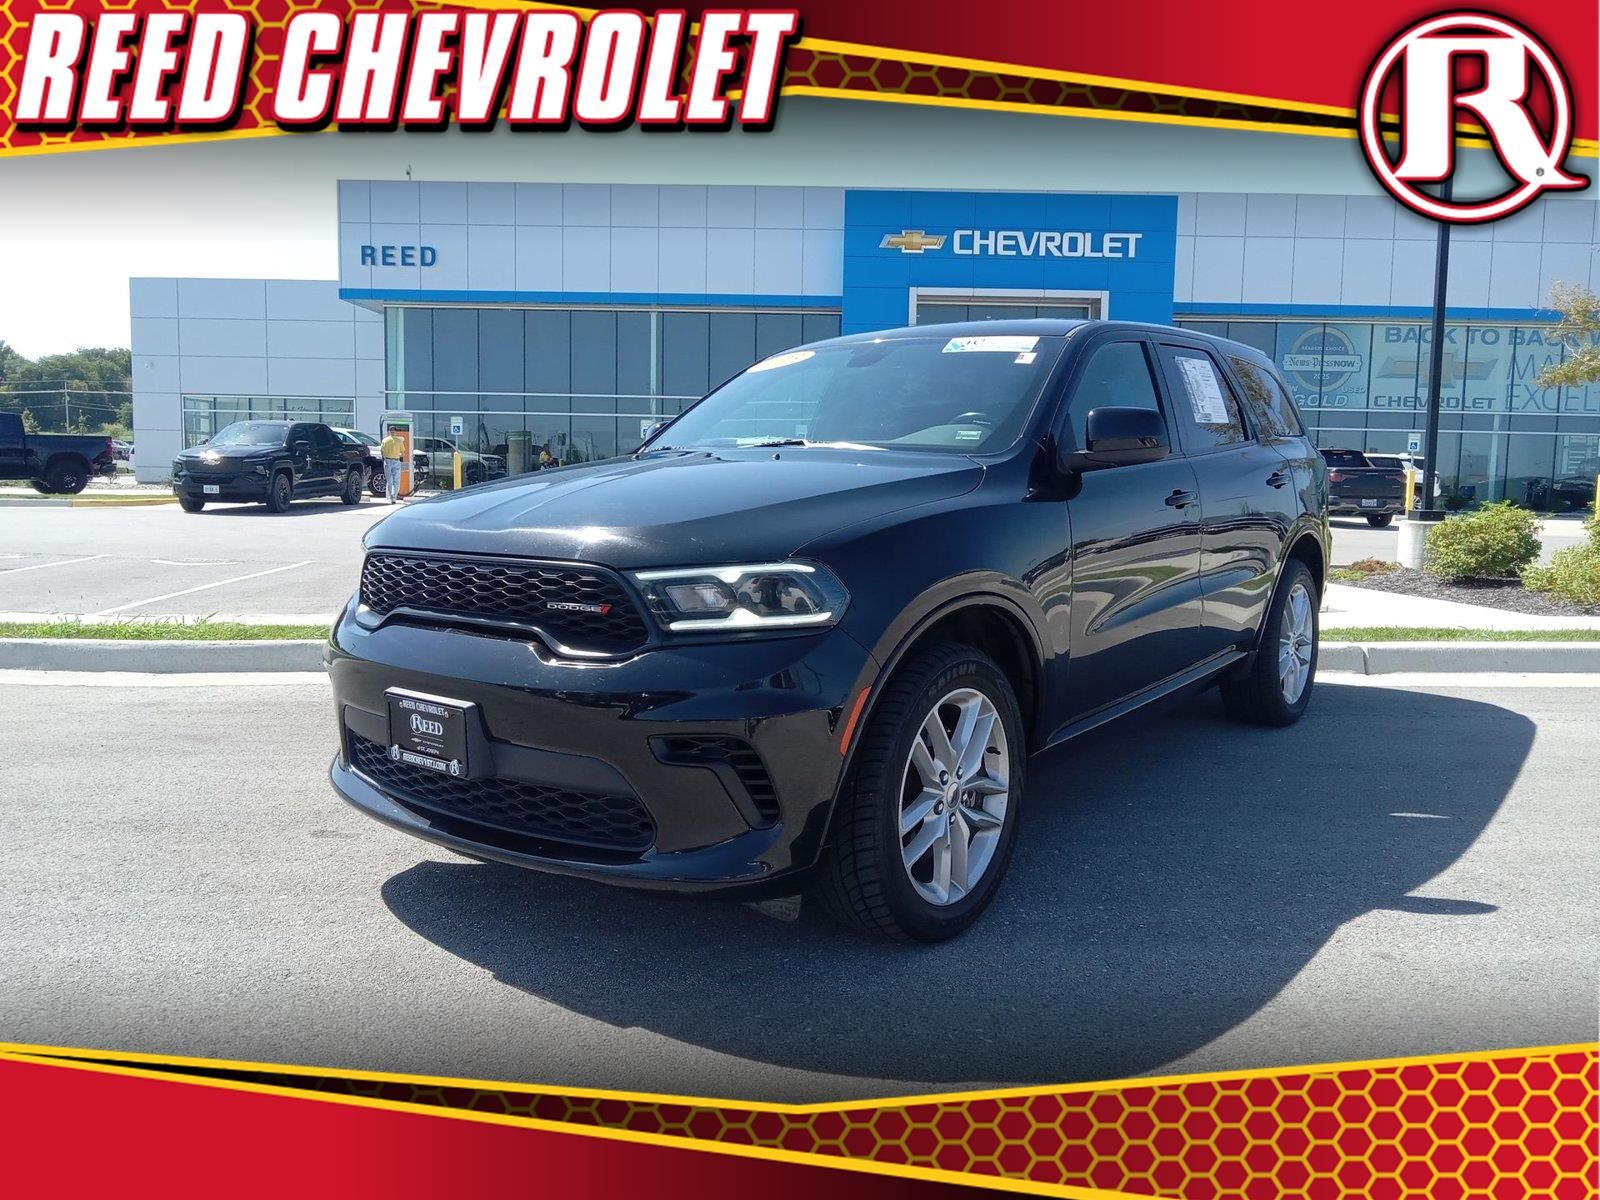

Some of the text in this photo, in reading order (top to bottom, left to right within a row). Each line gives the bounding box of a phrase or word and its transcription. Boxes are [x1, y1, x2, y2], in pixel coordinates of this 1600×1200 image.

[953, 229, 1143, 258] CHEVROLET
[361, 245, 436, 267] REED
[1385, 327, 1457, 344] BACK
[1466, 328, 1500, 345] TO
[1295, 394, 1349, 407] GOLD
[1373, 395, 1497, 409] CHEVROLET
[1505, 383, 1600, 411] EXCEL
[546, 602, 602, 613] DODGE
[410, 713, 443, 735] REED
